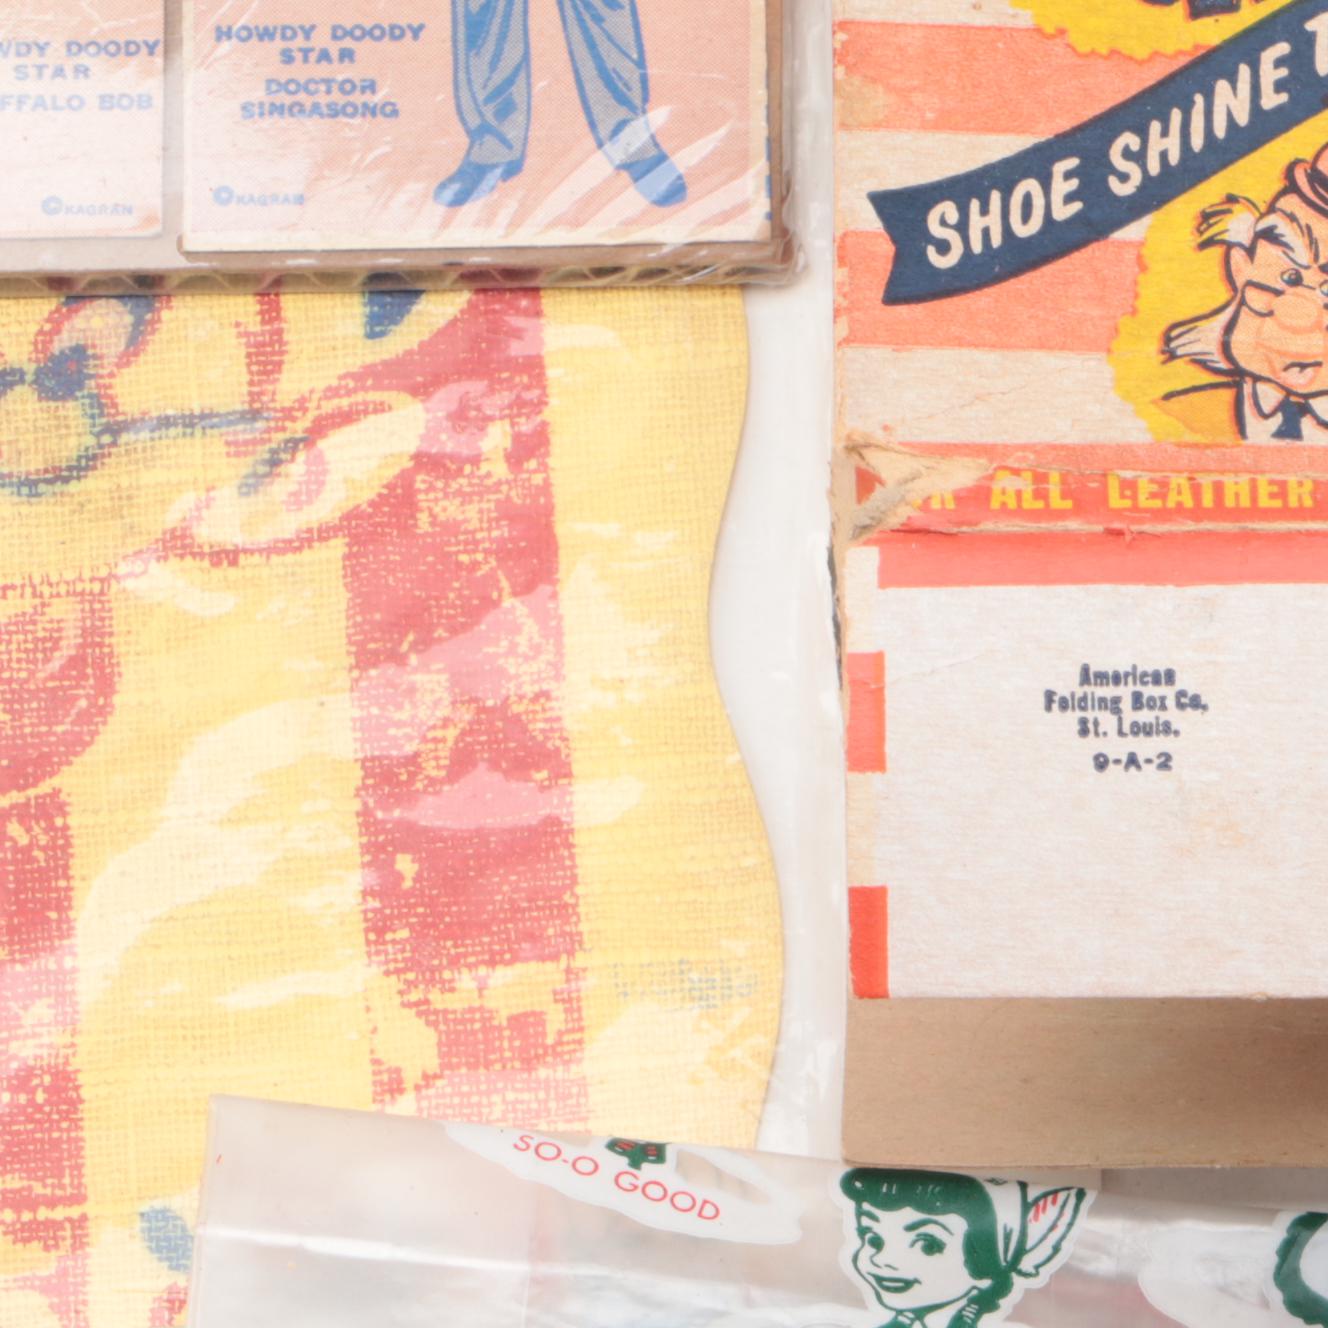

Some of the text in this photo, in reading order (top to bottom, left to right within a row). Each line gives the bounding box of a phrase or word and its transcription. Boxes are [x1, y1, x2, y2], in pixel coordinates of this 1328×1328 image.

[214, 23, 425, 42] HOWDY DOODY
[65, 39, 162, 59] DOODY
[280, 47, 356, 65] STAR
[13, 63, 92, 82] STAR
[265, 78, 377, 96] DOCTOR
[96, 93, 154, 111] BOB
[240, 100, 399, 120] SINGASONG
[926, 157, 1083, 270] SHOE
[1108, 41, 1292, 197] SHINE
[989, 469, 1073, 510] ALL
[1107, 472, 1314, 509] LEATHER
[1079, 663, 1176, 687] American
[1044, 689, 1209, 716] Folding Box Co.
[1077, 715, 1181, 738] St. Louis.
[512, 1134, 721, 1221] SO-O GOOD
